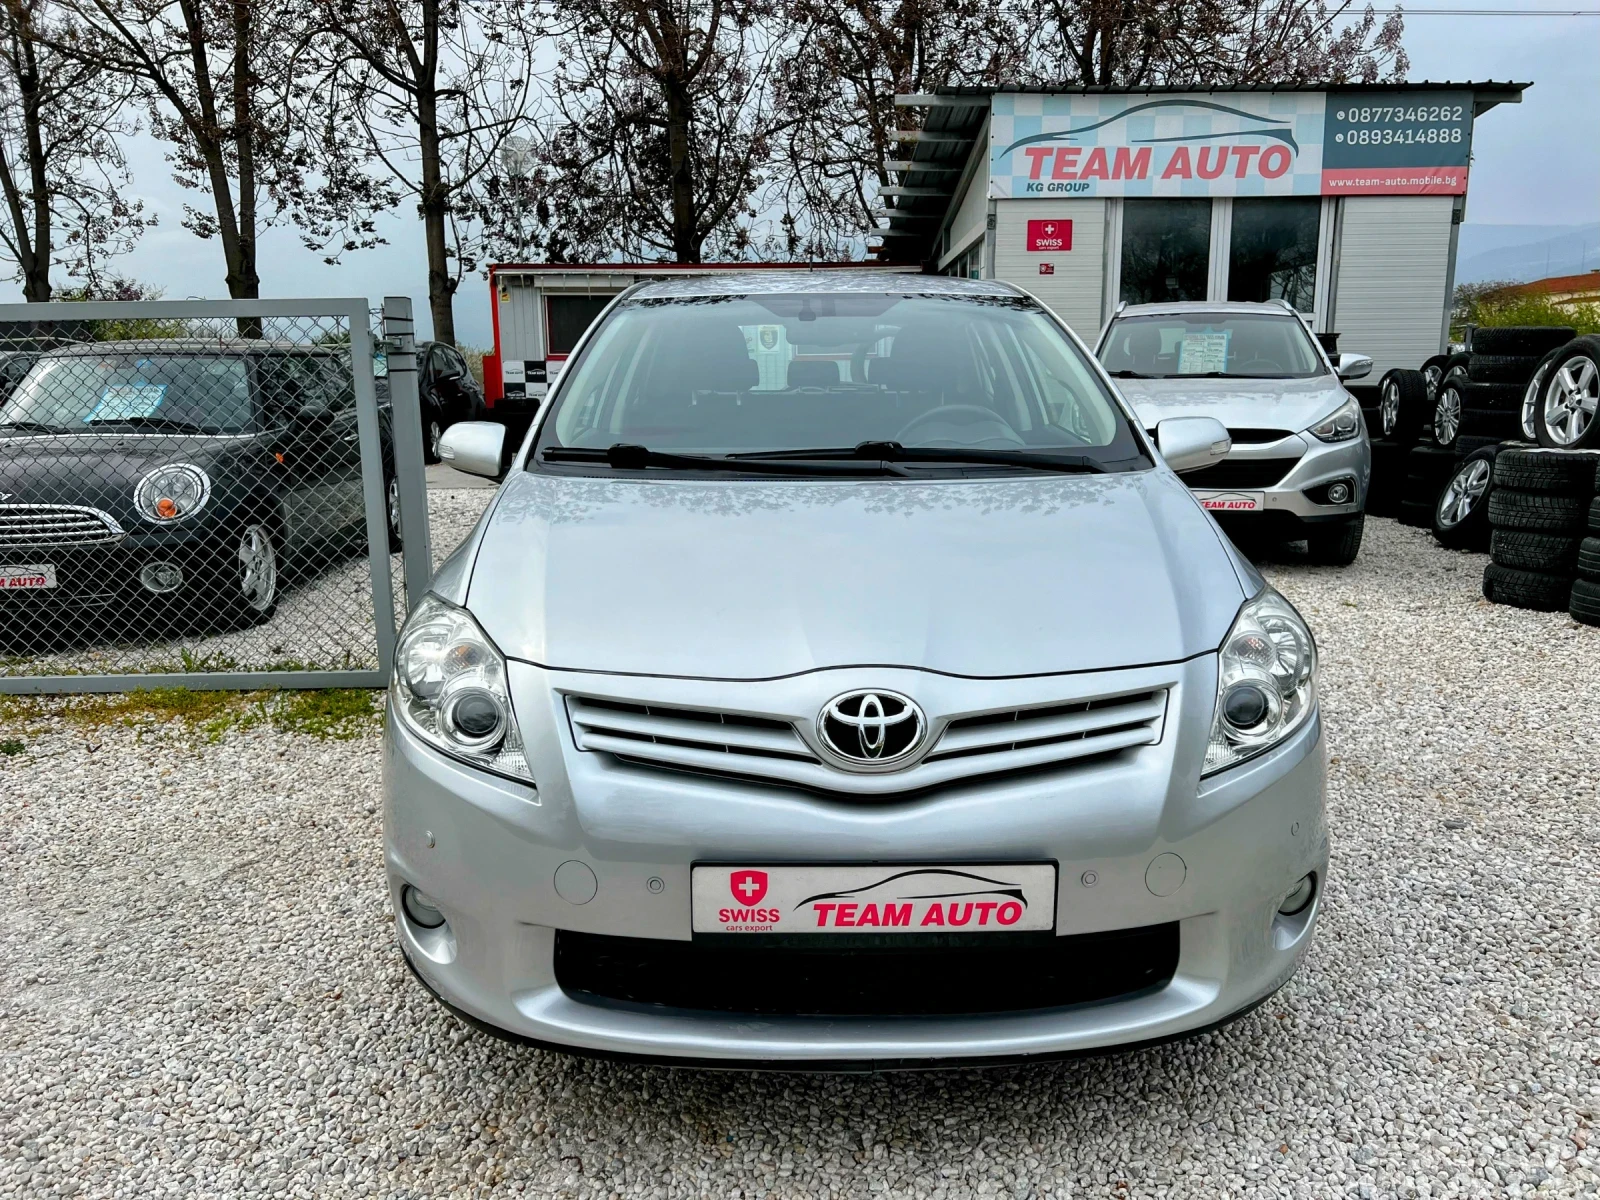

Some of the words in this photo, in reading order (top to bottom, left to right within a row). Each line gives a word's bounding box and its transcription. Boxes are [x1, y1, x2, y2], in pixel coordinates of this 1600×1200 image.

[1348, 106, 1463, 123] 0877346262
[1347, 128, 1462, 145] 0893414888
[1025, 147, 1152, 180] TEAM
[1161, 145, 1292, 179] AUTO
[1026, 183, 1044, 193] KG
[1047, 182, 1090, 193] GROUP
[1329, 175, 1457, 188] www.team-auto.mobile.bg
[1036, 238, 1062, 246] SWISS
[9, 577, 46, 586] AUTO
[718, 908, 780, 923] SWISS
[813, 903, 913, 927] TEAM
[920, 901, 1022, 926] AUTO
[744, 925, 773, 933] export
